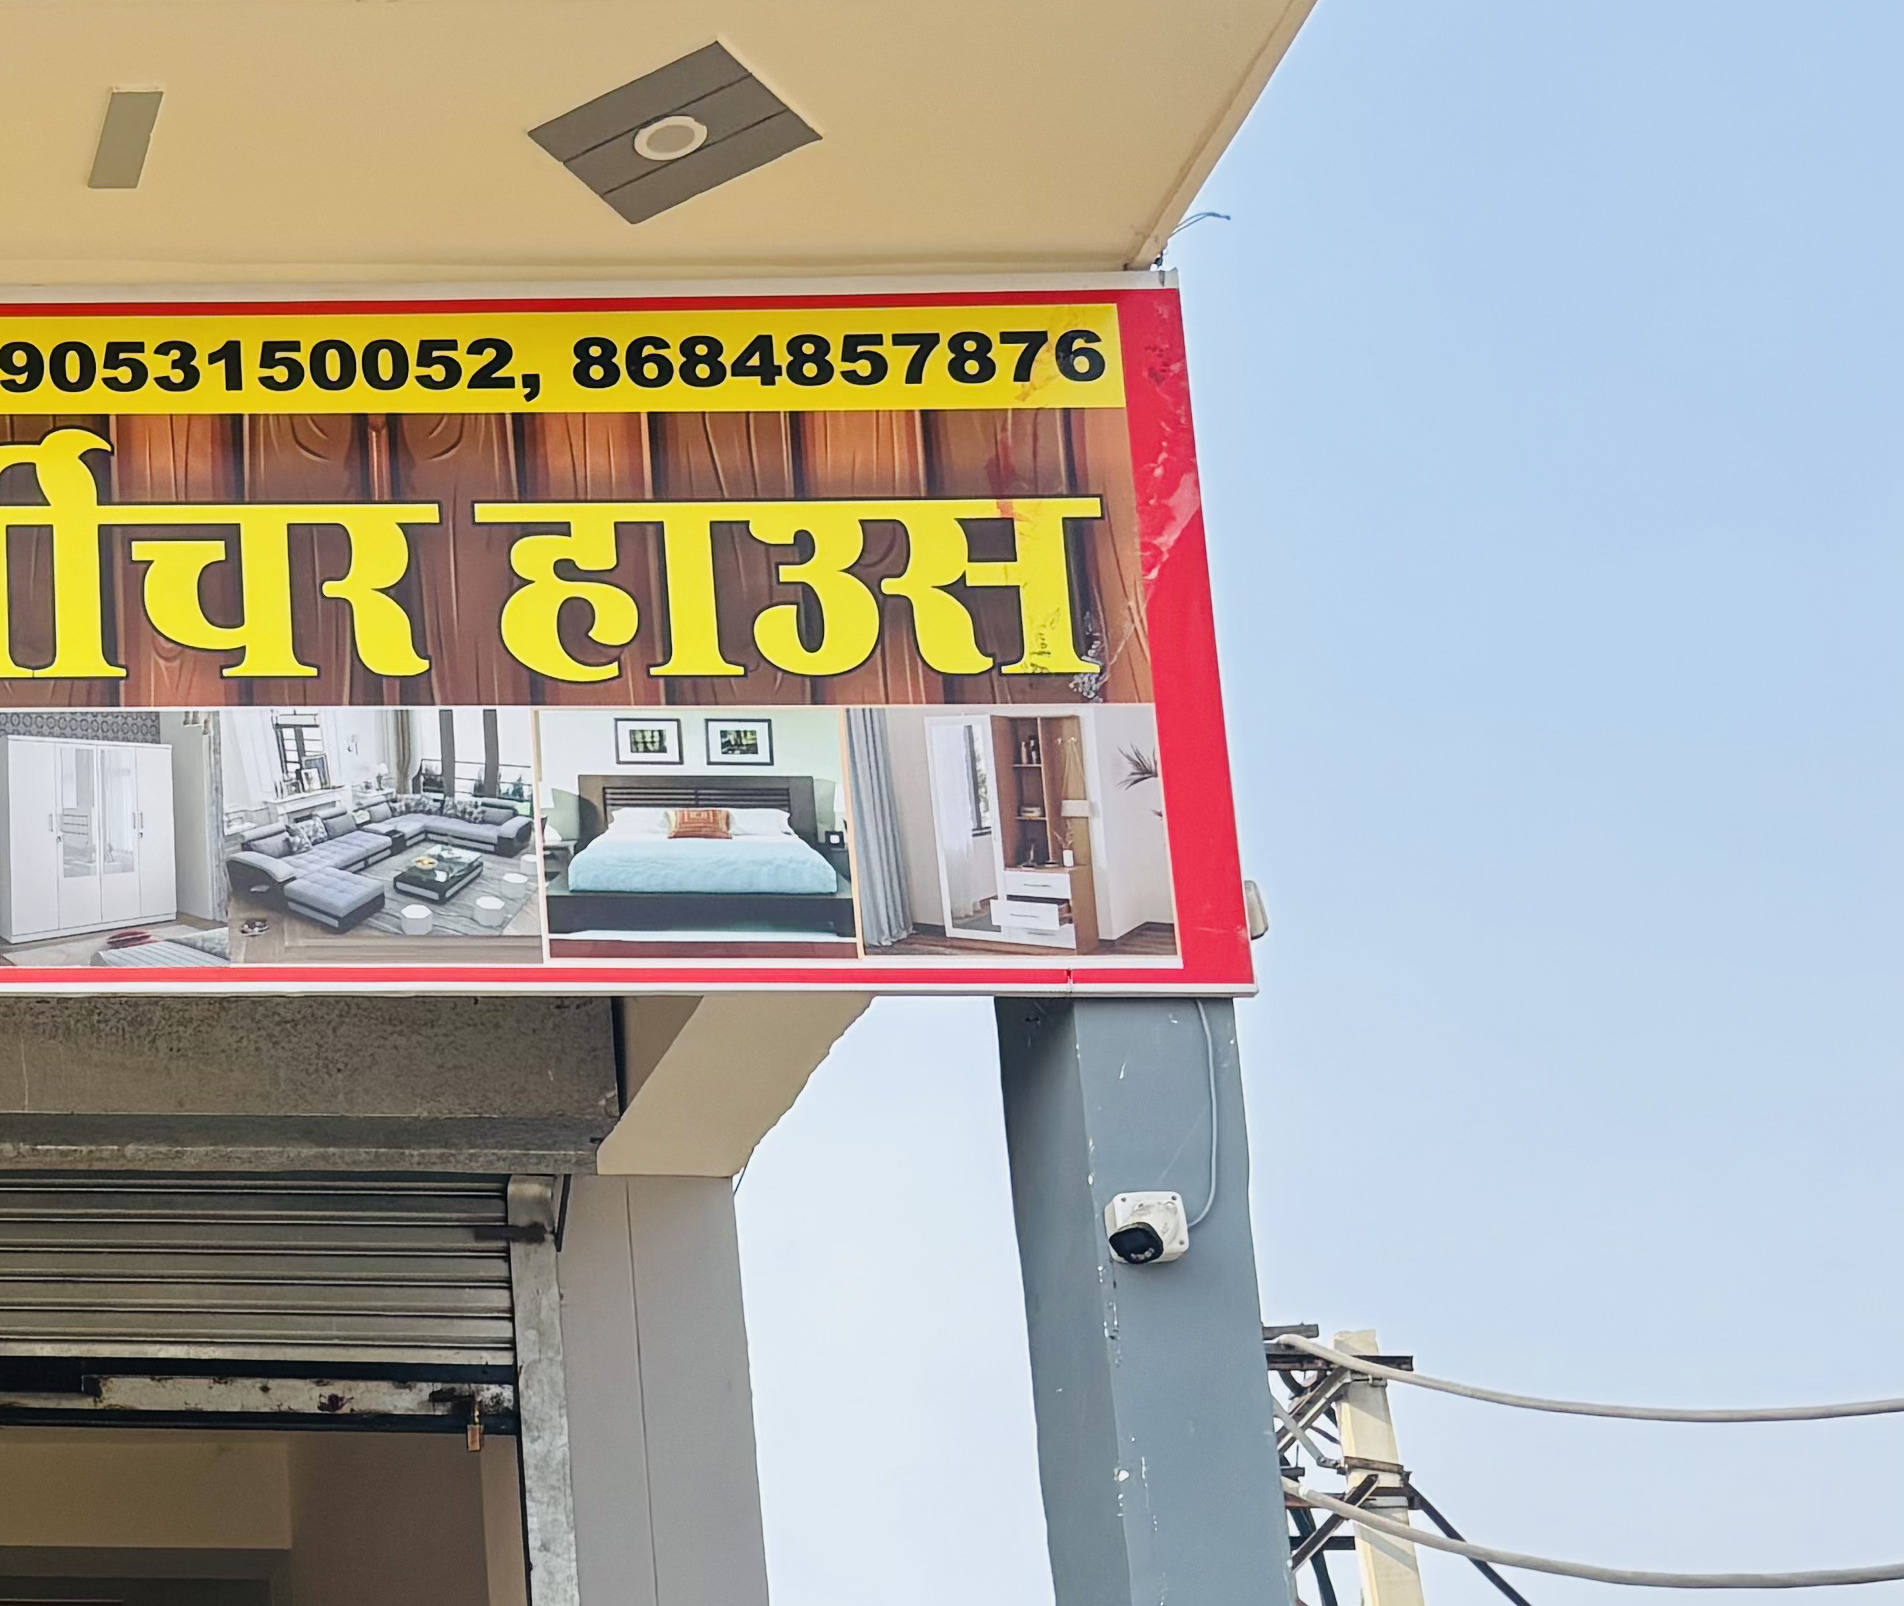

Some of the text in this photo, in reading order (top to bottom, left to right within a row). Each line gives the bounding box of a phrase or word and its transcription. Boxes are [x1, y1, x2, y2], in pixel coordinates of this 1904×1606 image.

[0, 337, 541, 406] 9053150052,
[572, 329, 1106, 390] 8684857876
[474, 493, 1102, 680] हाउस
